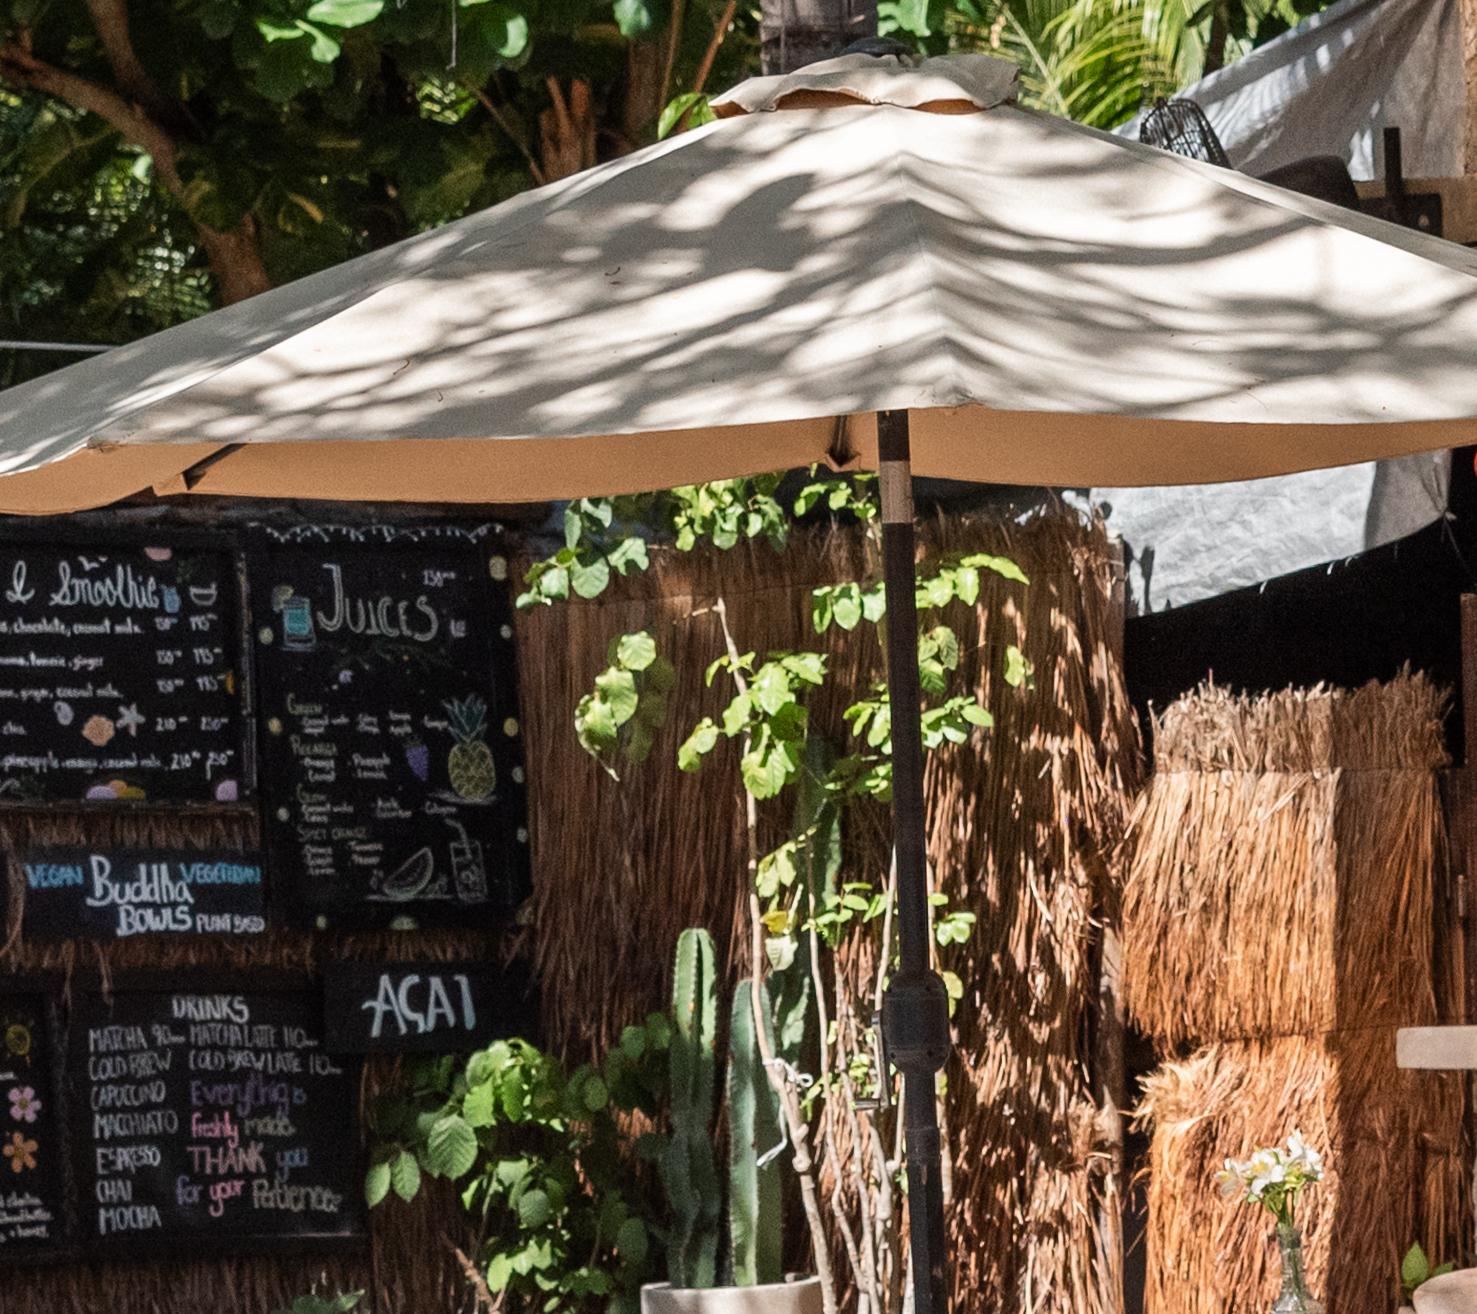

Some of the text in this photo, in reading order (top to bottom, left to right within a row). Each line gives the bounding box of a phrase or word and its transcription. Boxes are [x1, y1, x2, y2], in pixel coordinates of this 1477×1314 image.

[48, 560, 160, 609] Smoothie
[316, 562, 440, 643] JUICES
[24, 862, 84, 889] VEGAN
[85, 854, 195, 907] Buddha
[115, 904, 192, 937] BOWLS
[196, 913, 232, 934] PLANT
[172, 994, 250, 1025] DRINKS
[361, 973, 477, 1038] AÇAI
[88, 1025, 148, 1054] MATCHA
[189, 1023, 244, 1047] MATCHA
[88, 1050, 173, 1081] COLD BREW
[190, 1110, 240, 1149] freshly
[95, 1145, 161, 1176] ESPRESSO
[186, 1141, 309, 1183] THANK you
[95, 1178, 133, 1204] CHAI
[175, 1174, 203, 1206] for
[208, 1179, 245, 1218] your
[98, 1205, 162, 1235] MOCHA
